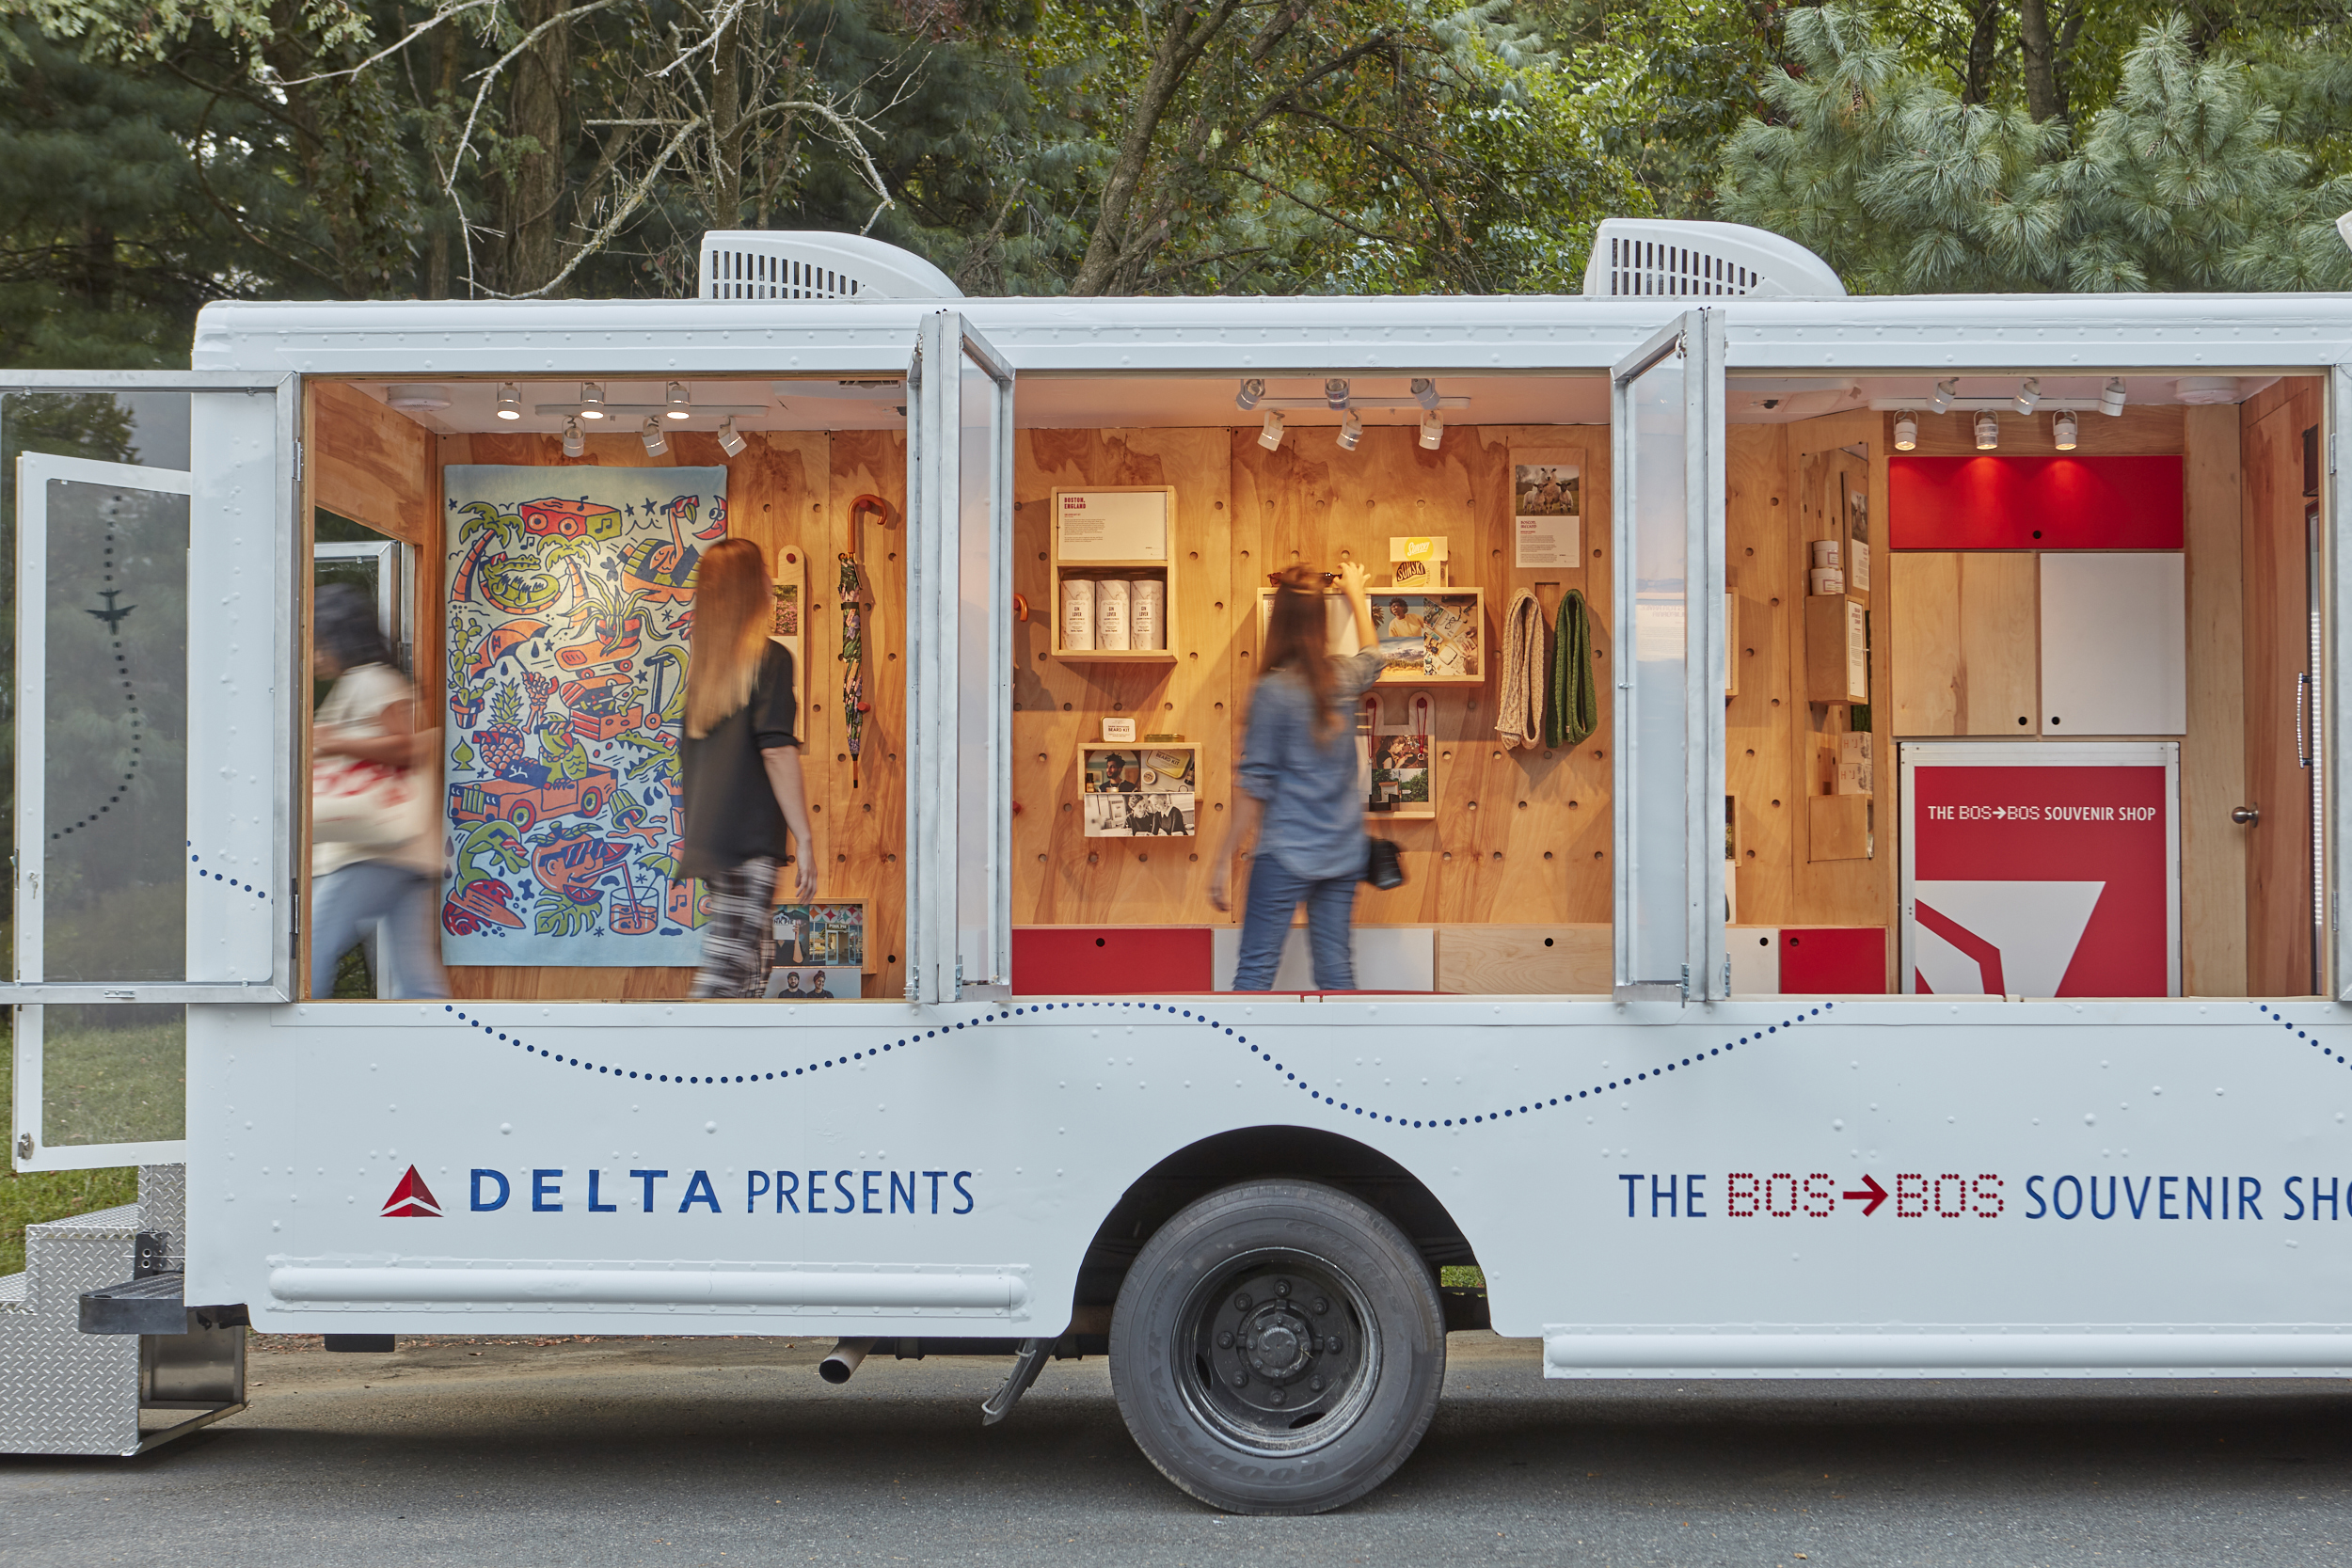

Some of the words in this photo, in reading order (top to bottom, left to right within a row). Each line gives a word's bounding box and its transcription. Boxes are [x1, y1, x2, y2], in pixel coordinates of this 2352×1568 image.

[1397, 562, 1424, 581] SUNSKI
[1156, 753, 1170, 762] BEARD
[1928, 806, 1955, 820] THE
[1959, 806, 1992, 820] BOS
[2007, 806, 2041, 820] BOS
[2044, 806, 2115, 821] SOUVENIR
[2119, 806, 2156, 821] SHOP
[469, 1168, 723, 1213] DELTA
[747, 1169, 974, 1215] PRESENTS
[1618, 1174, 1707, 1218] THE
[1727, 1173, 1836, 1218] BOS
[1896, 1173, 2005, 1218] BOS
[2025, 1175, 2264, 1221] SOUVENIR
[2283, 1175, 2352, 1221] SH
